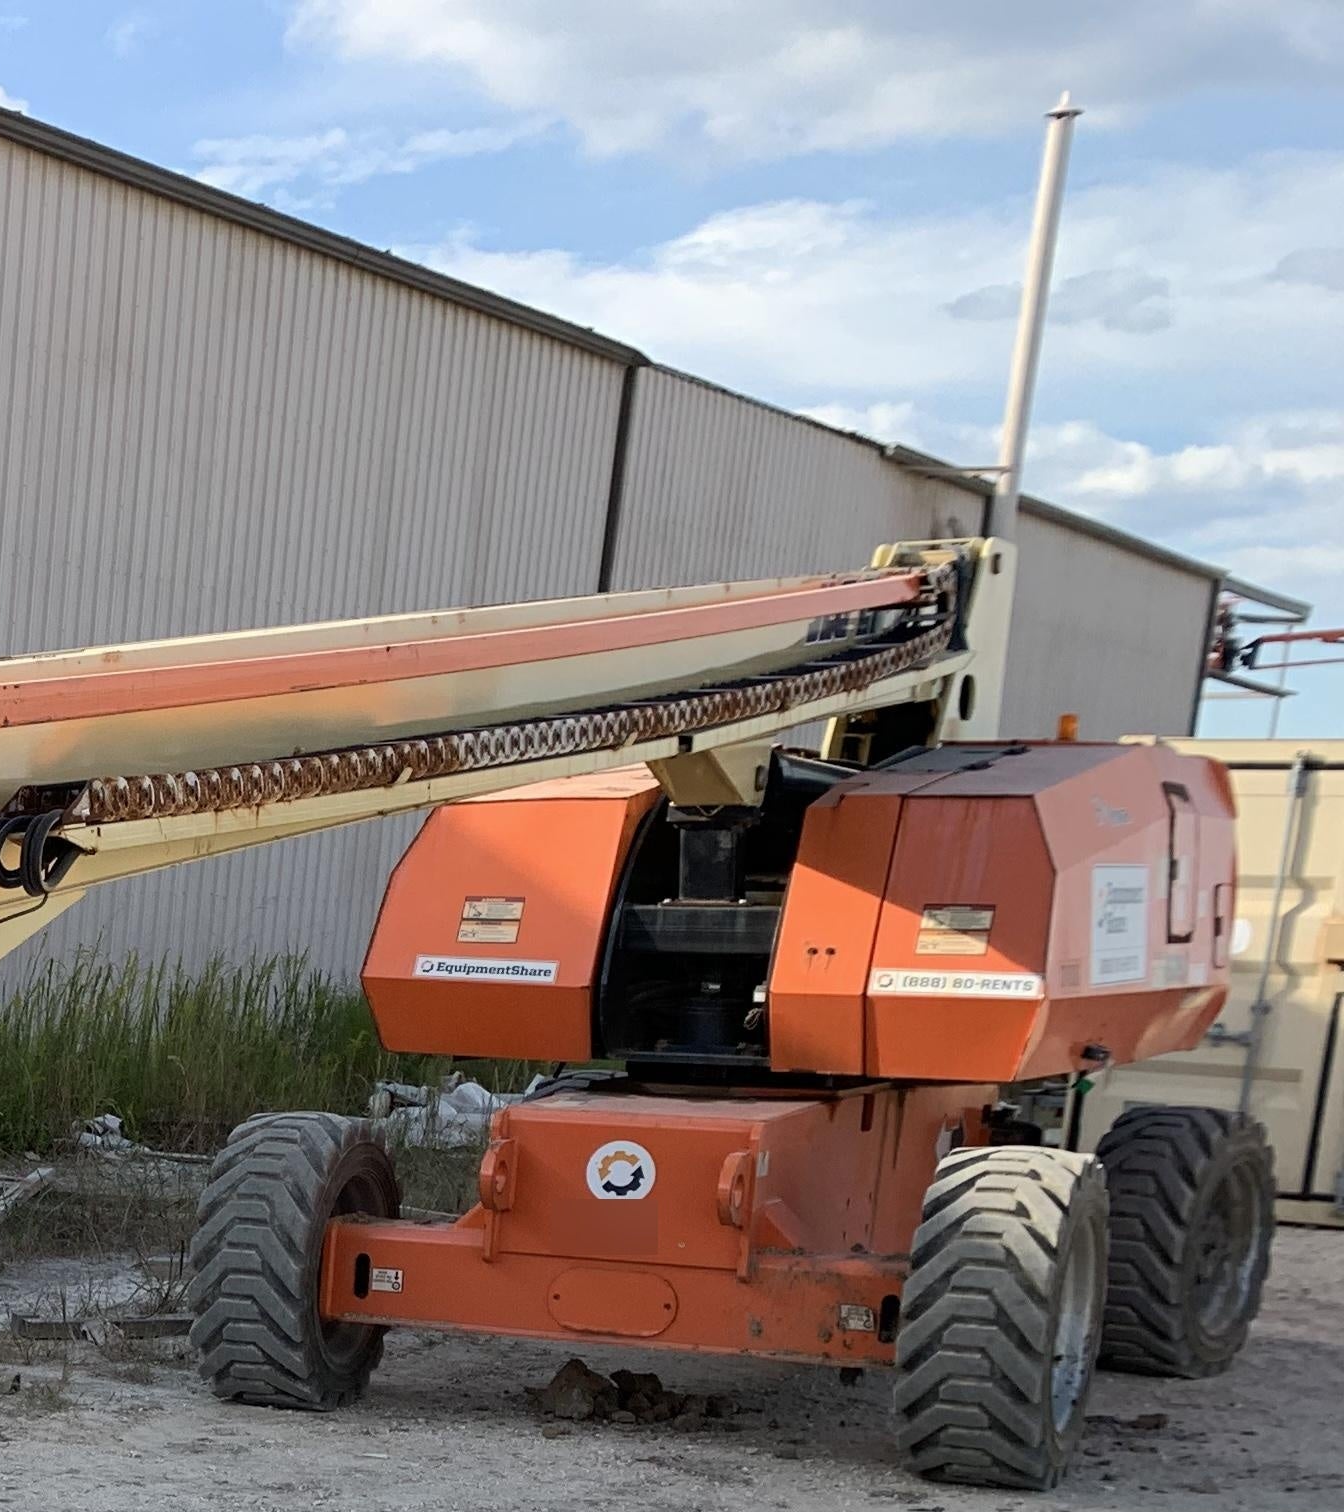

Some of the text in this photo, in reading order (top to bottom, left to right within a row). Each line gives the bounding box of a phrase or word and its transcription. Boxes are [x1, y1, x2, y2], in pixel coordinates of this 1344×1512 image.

[436, 961, 552, 977] EquipmentShare
[902, 975, 1034, 991] (888) 80-RENTS
